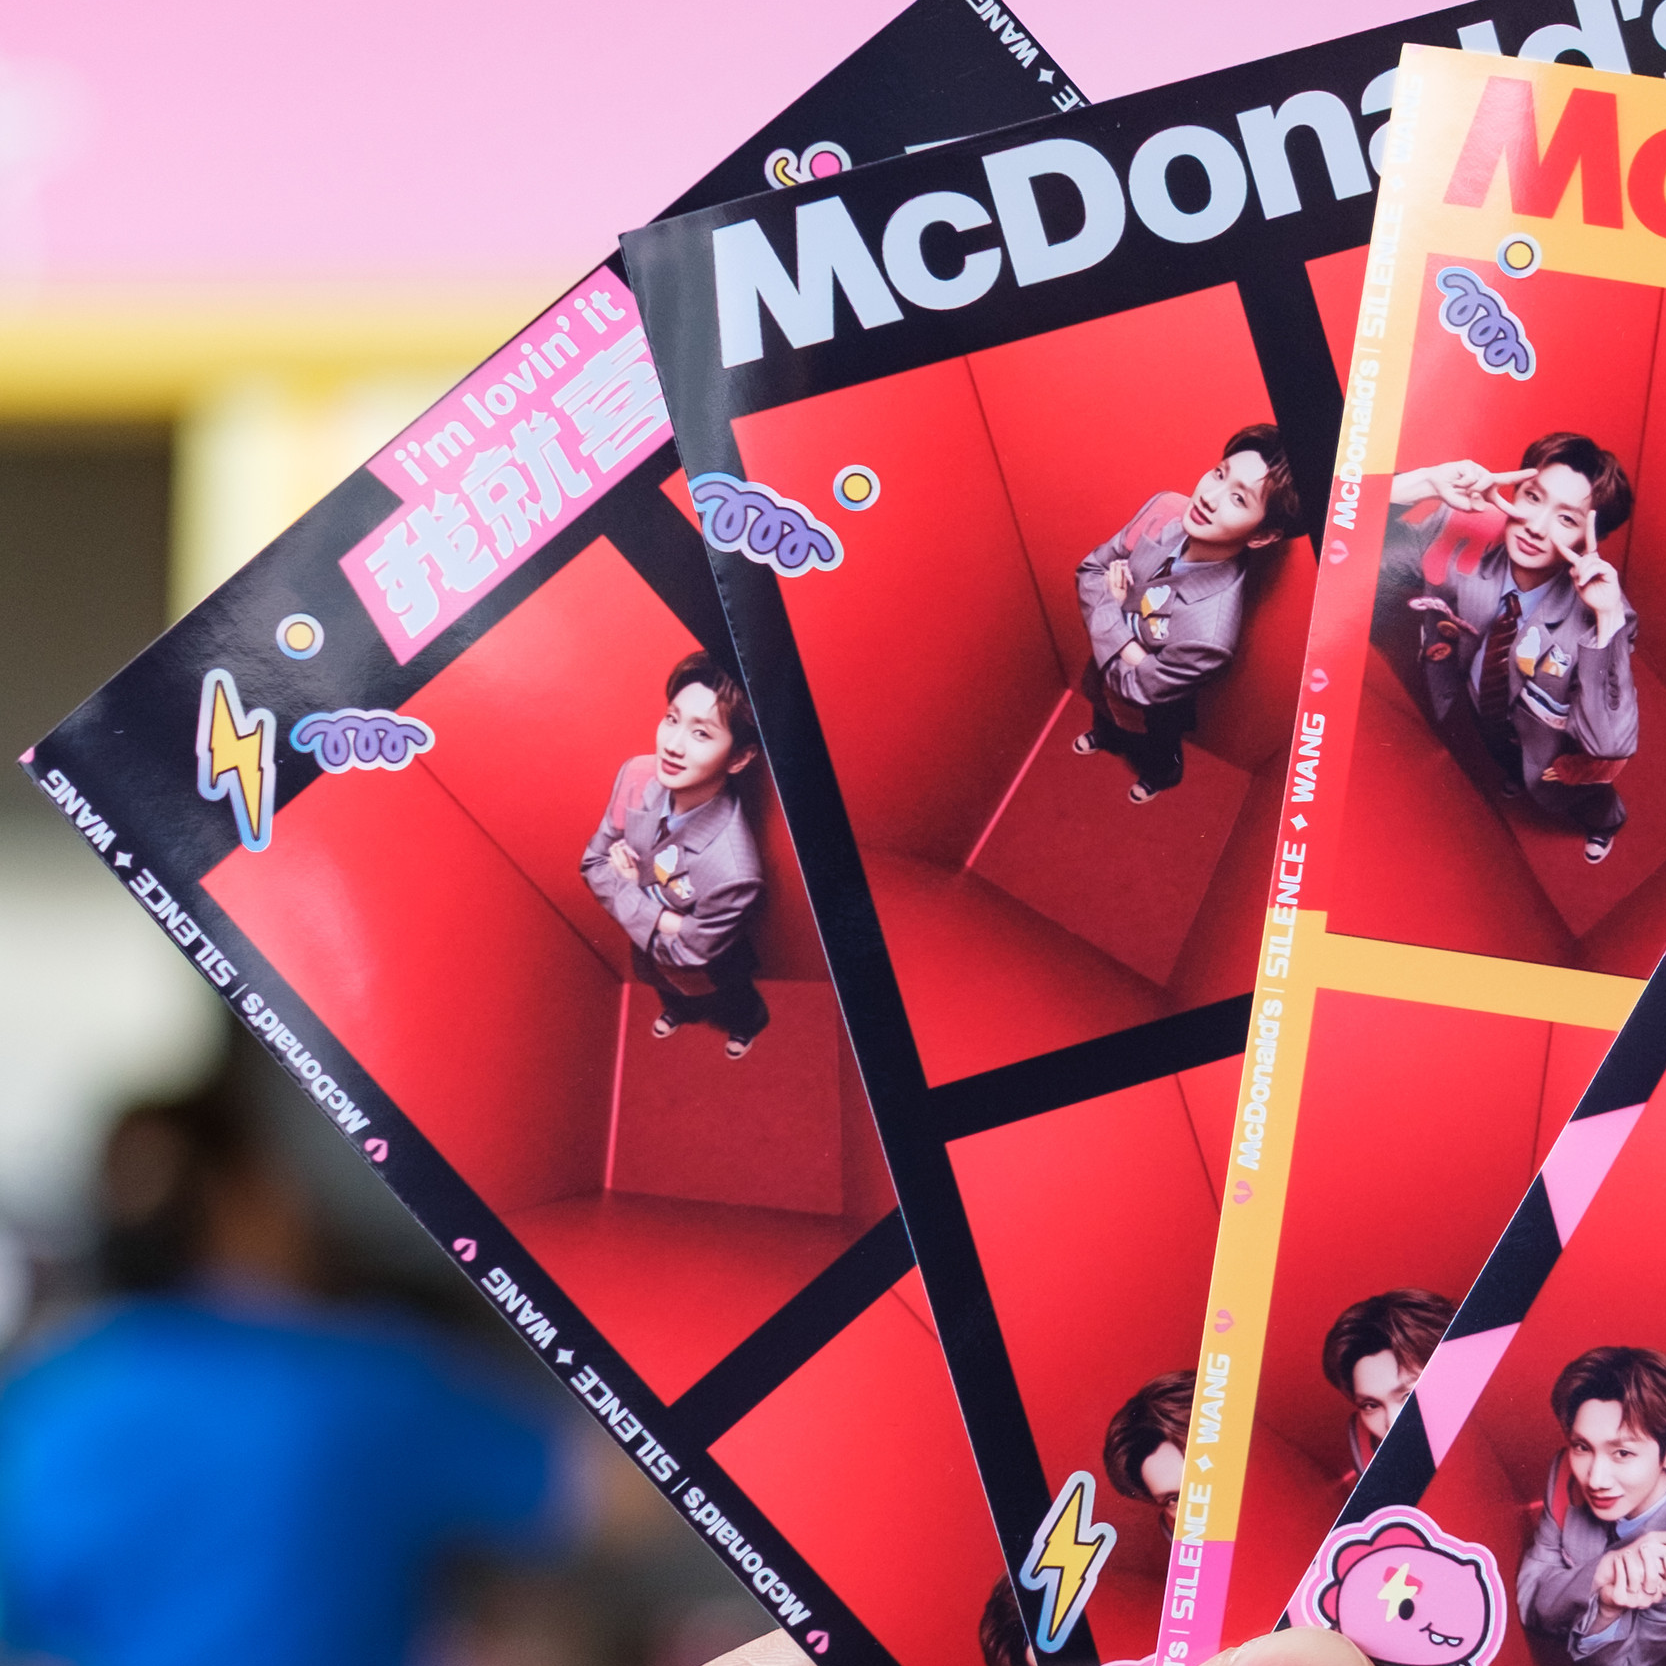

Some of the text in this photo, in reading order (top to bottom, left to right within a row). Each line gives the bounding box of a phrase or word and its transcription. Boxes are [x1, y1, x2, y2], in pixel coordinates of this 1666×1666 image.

[574, 290, 626, 334] it
[1333, 359, 1379, 530] McDonald's
[1364, 201, 1403, 339] SILENCE
[40, 769, 371, 1134] McDonald's SILENCE WANG
[1237, 712, 1325, 1170] McDonald's SILENCE WANG
[481, 1267, 812, 1626] McDonald's SILENCE WANG
[1171, 1482, 1212, 1620] SILENCE
[1196, 1352, 1231, 1444] WANG
